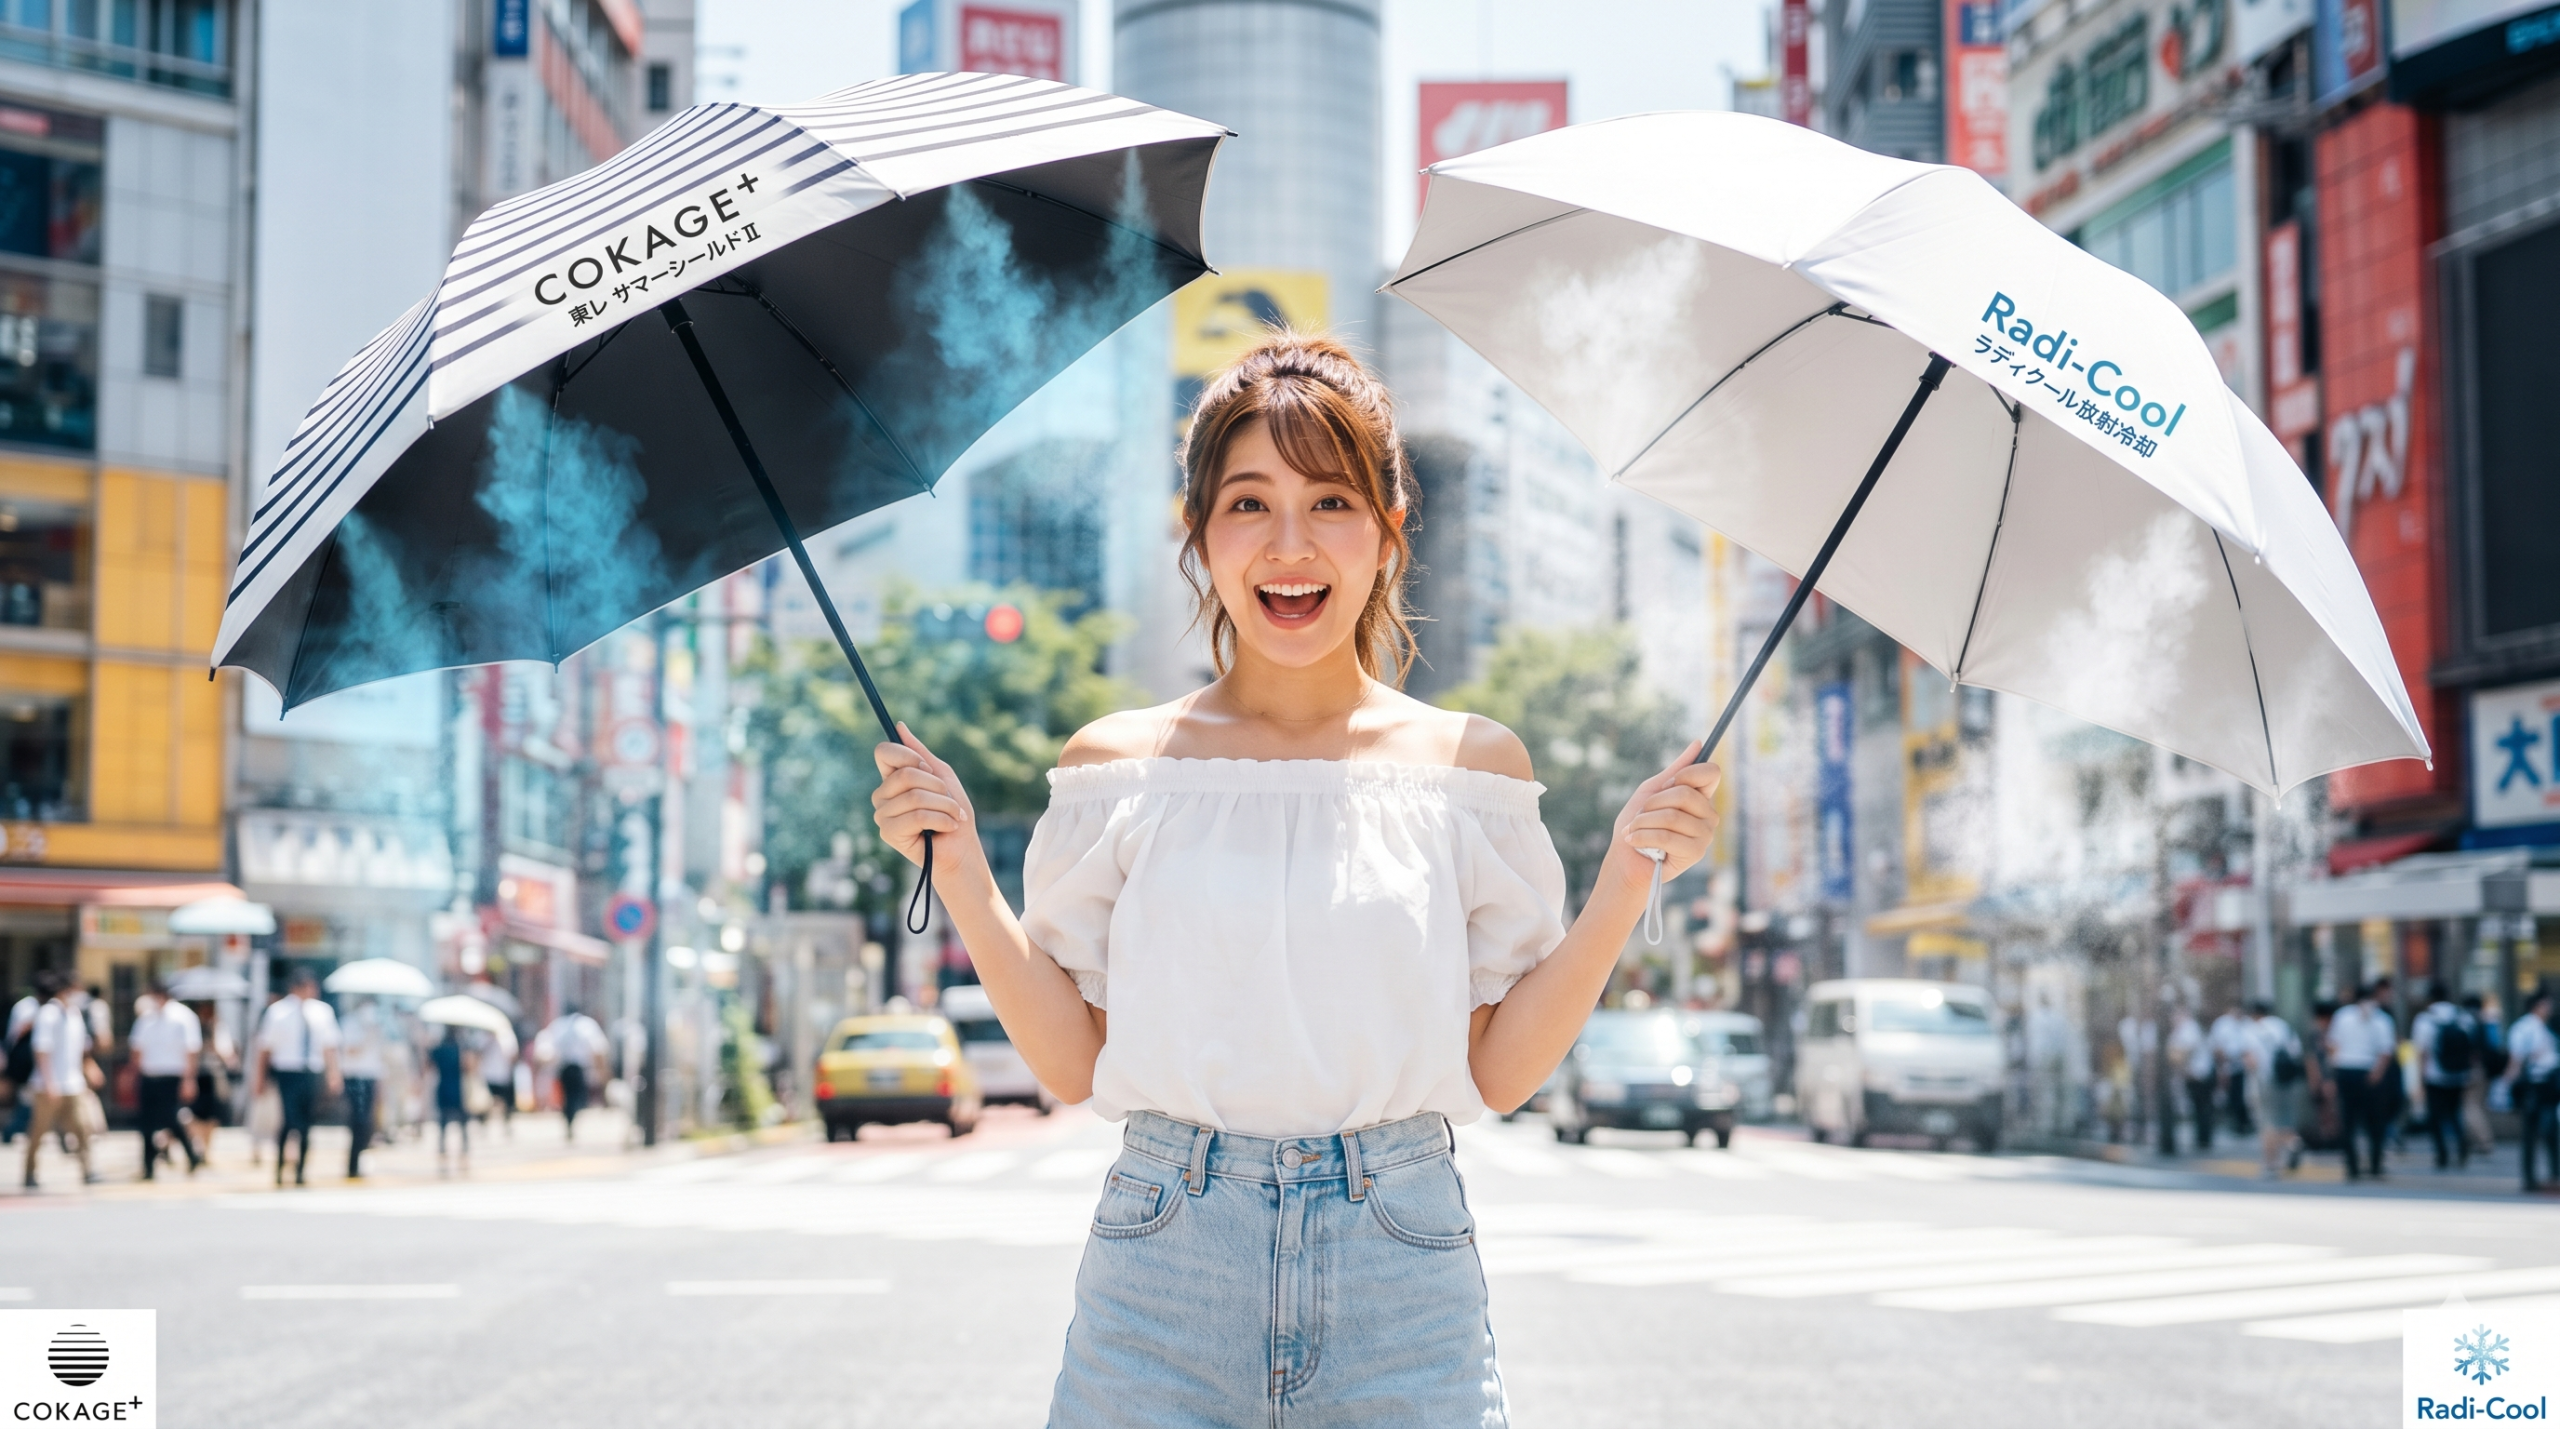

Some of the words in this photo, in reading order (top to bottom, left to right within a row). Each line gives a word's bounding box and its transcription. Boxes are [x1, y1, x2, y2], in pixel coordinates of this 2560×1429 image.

[534, 172, 759, 306] COKAGE+
[567, 300, 608, 328] 東レ
[1980, 290, 2187, 438] Radi-Cool
[1973, 333, 2159, 459] ラディクール放射冷却
